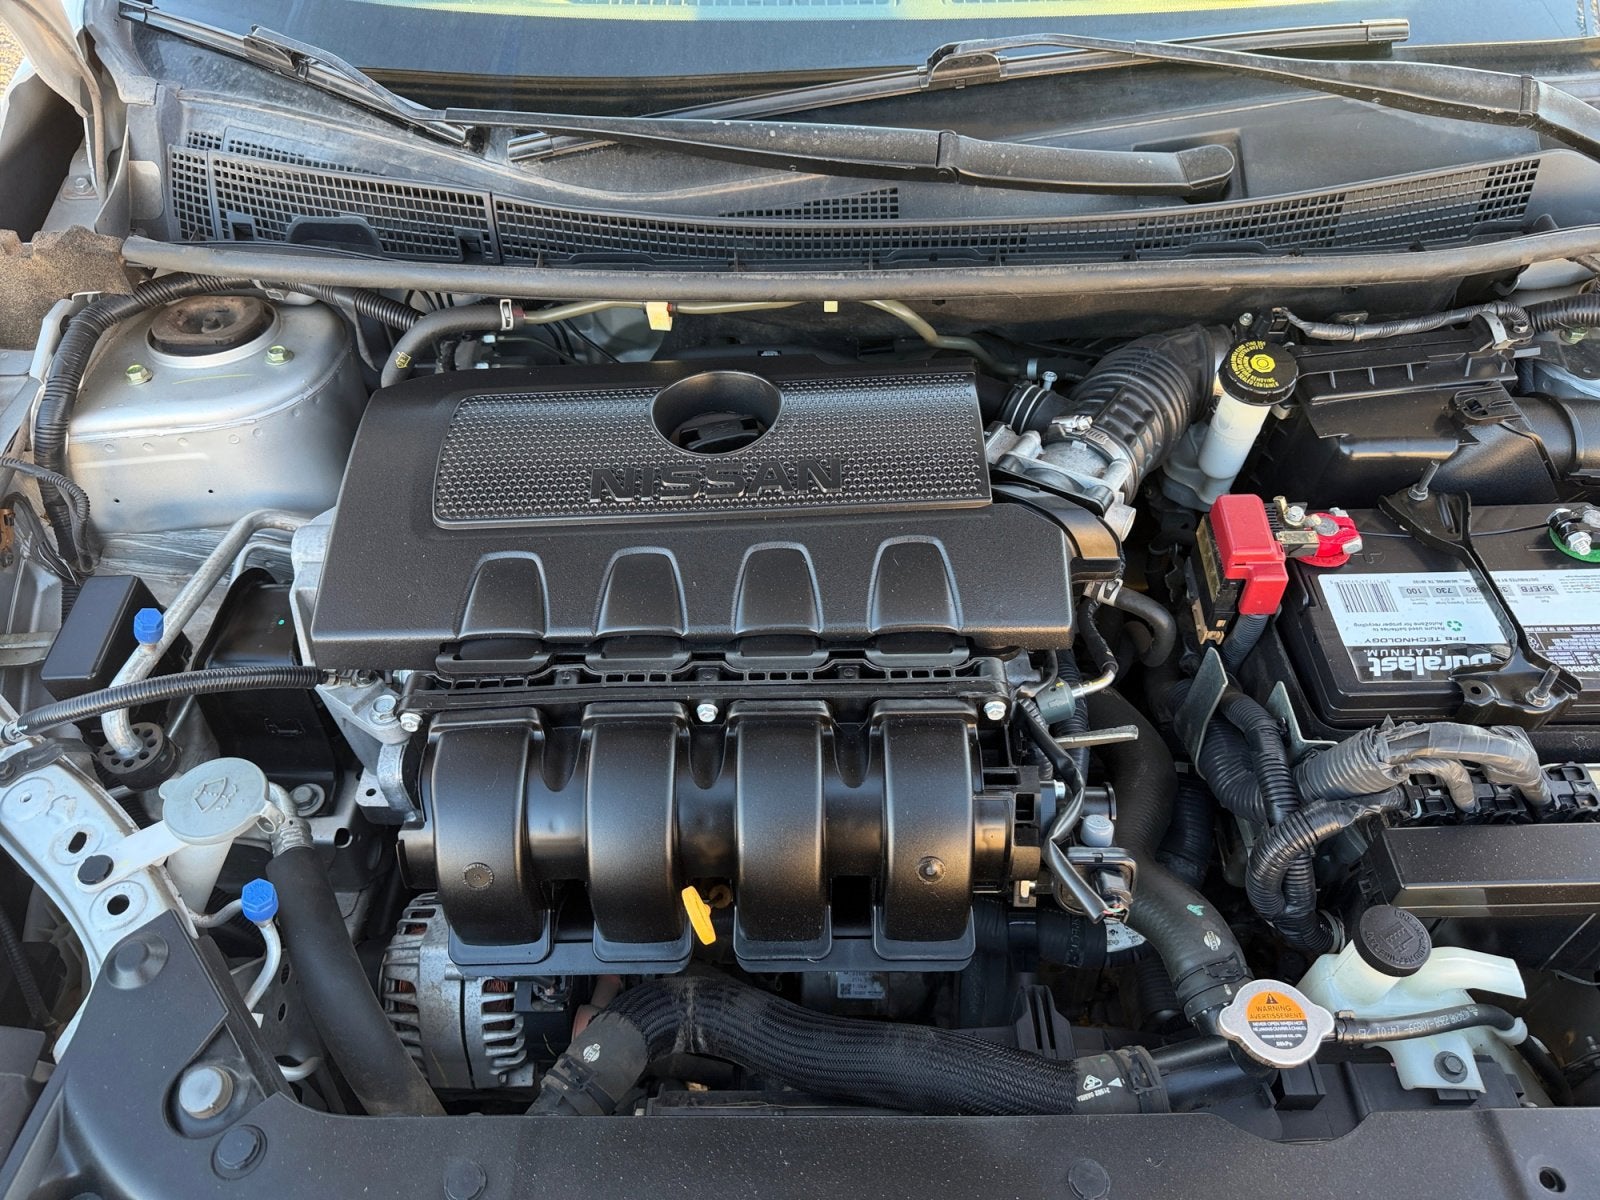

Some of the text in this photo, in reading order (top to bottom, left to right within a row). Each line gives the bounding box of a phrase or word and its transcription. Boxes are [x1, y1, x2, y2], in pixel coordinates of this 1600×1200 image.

[590, 458, 843, 502] NISSAN
[1521, 585, 1555, 593] 35-EFB
[1364, 636, 1441, 644] TECHNOLOGY
[1256, 1005, 1292, 1013] WARNING
[1249, 1012, 1303, 1020] AVERTISSEMENT
